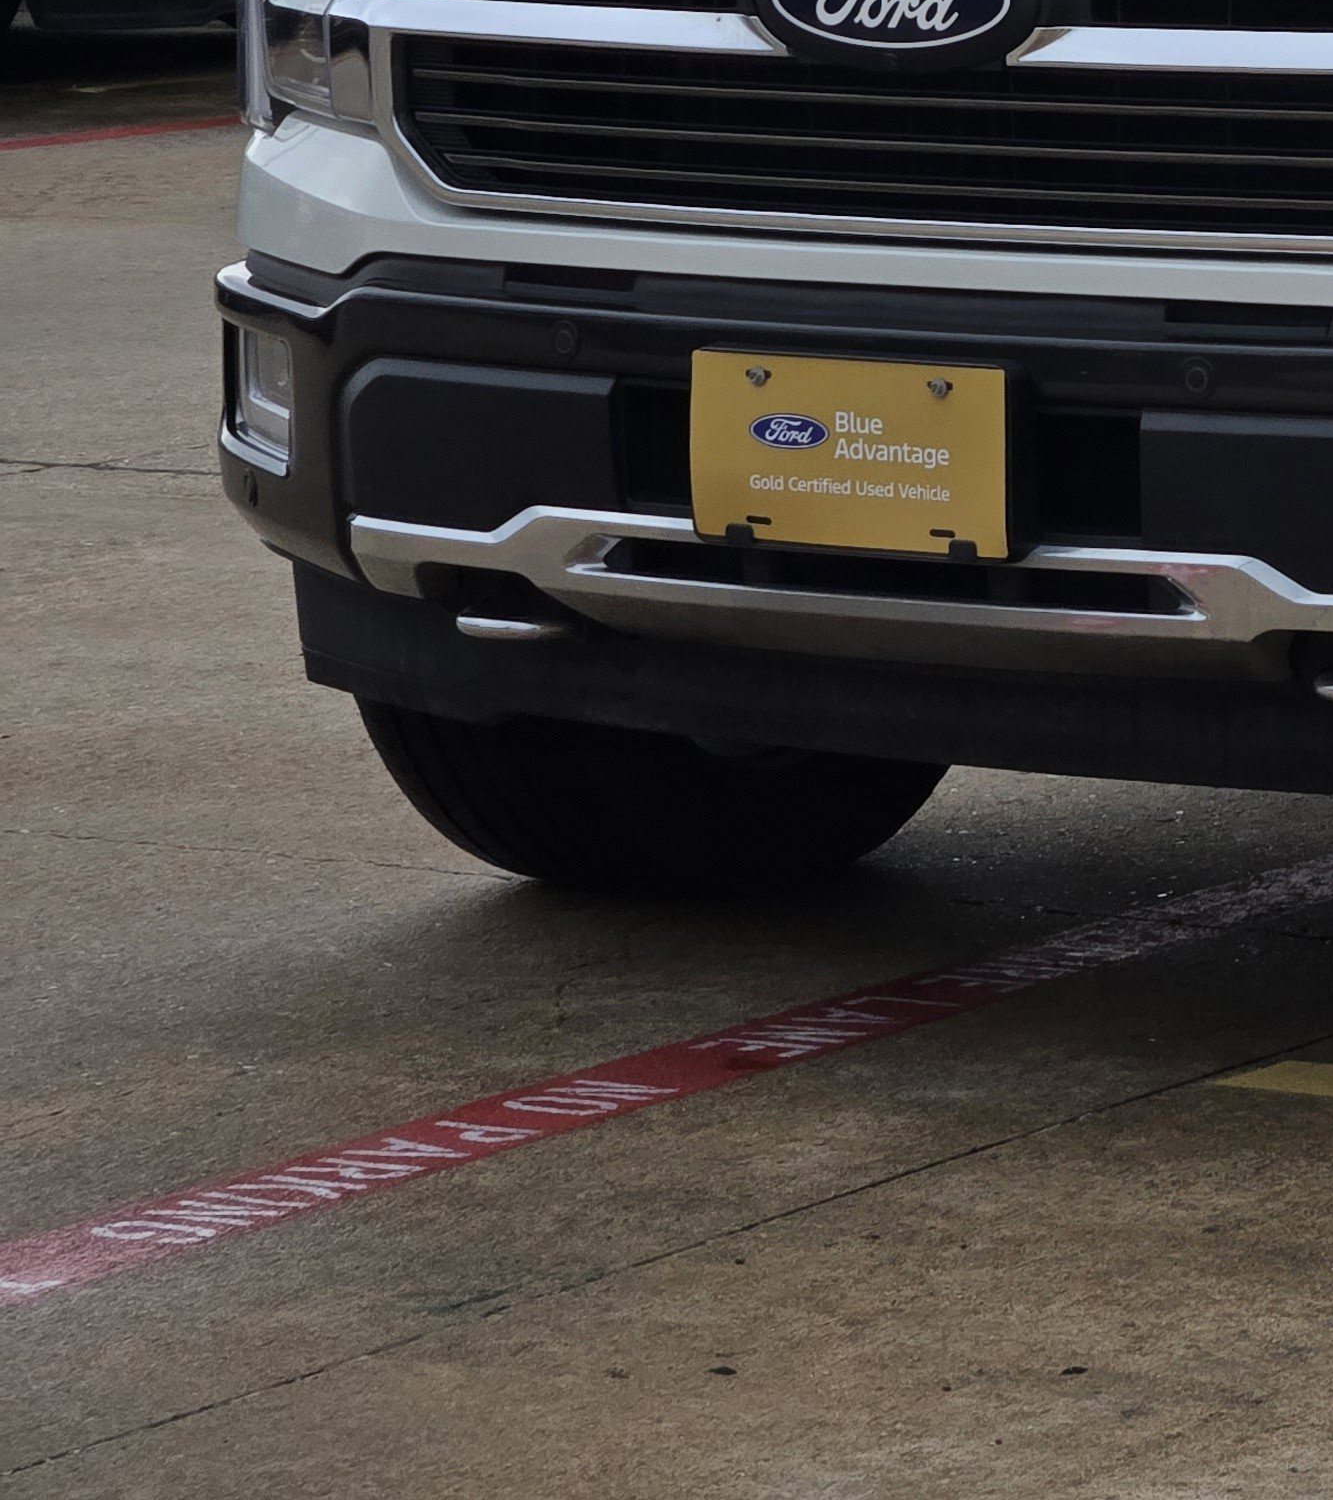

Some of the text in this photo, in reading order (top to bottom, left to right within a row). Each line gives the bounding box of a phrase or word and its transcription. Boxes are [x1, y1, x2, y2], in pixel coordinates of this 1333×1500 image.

[764, 417, 814, 445] Ford
[834, 411, 883, 436] Blue
[834, 437, 950, 469] Advantage
[749, 473, 951, 502] Gold Certified Used Vehicle
[687, 996, 957, 1058] LANE
[502, 1078, 681, 1117] NO
[90, 1118, 546, 1246] PARKING
